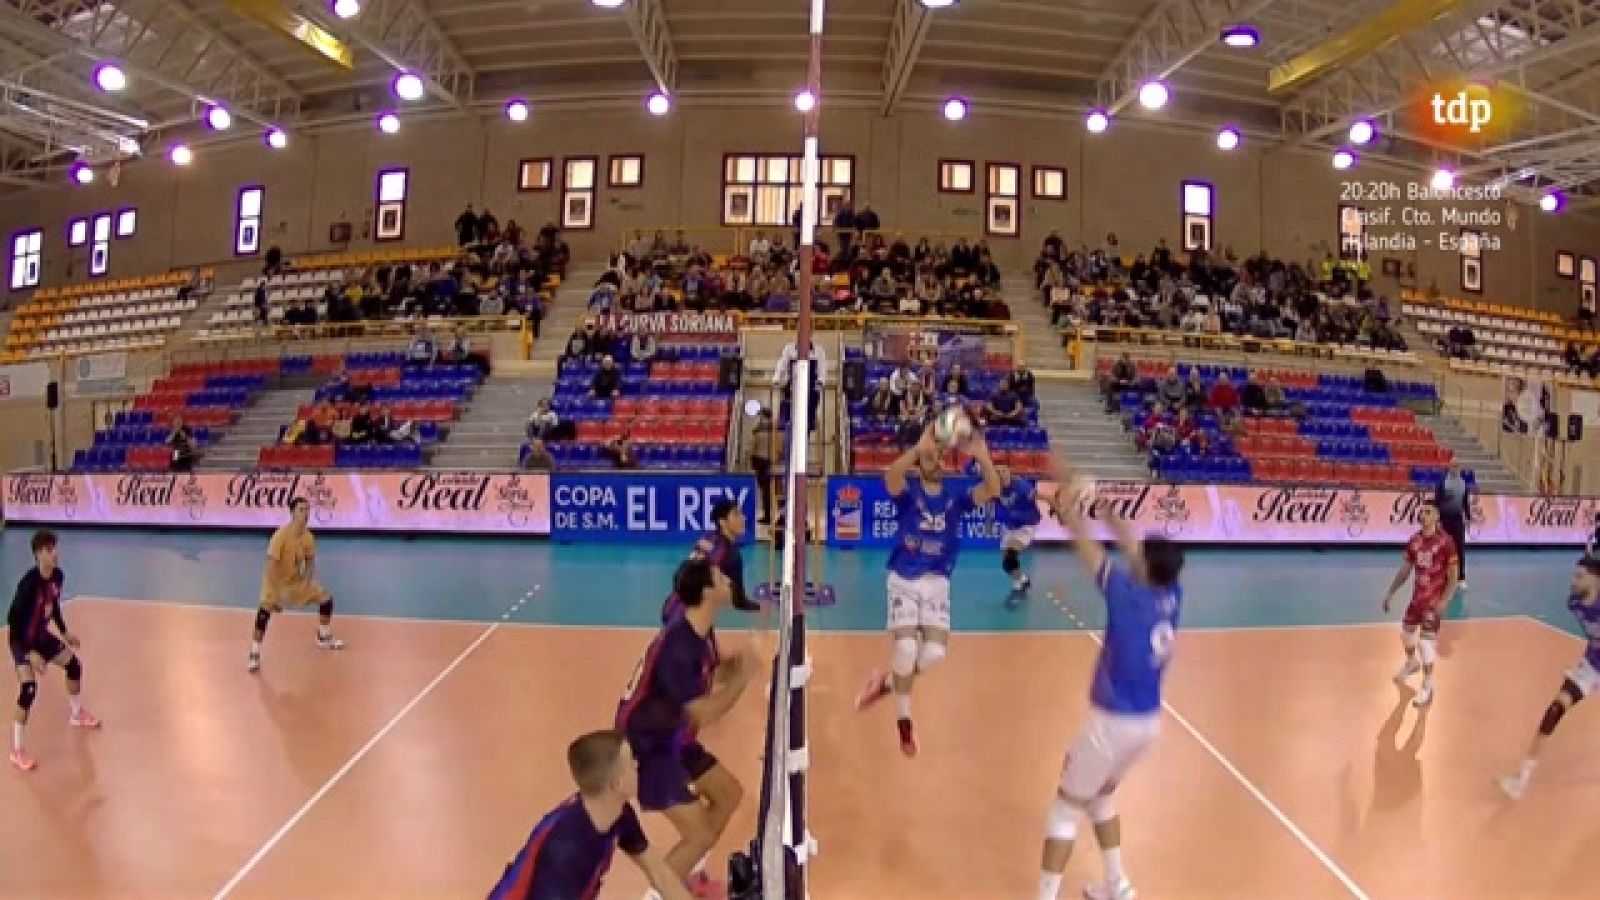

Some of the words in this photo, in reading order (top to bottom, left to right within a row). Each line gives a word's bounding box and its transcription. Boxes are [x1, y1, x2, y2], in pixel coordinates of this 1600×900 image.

[398, 474, 490, 510] Real
[554, 484, 617, 506] COPA
[627, 486, 668, 531] EL
[679, 486, 750, 531] REY
[1252, 488, 1338, 522] Real
[554, 512, 578, 529] DE
